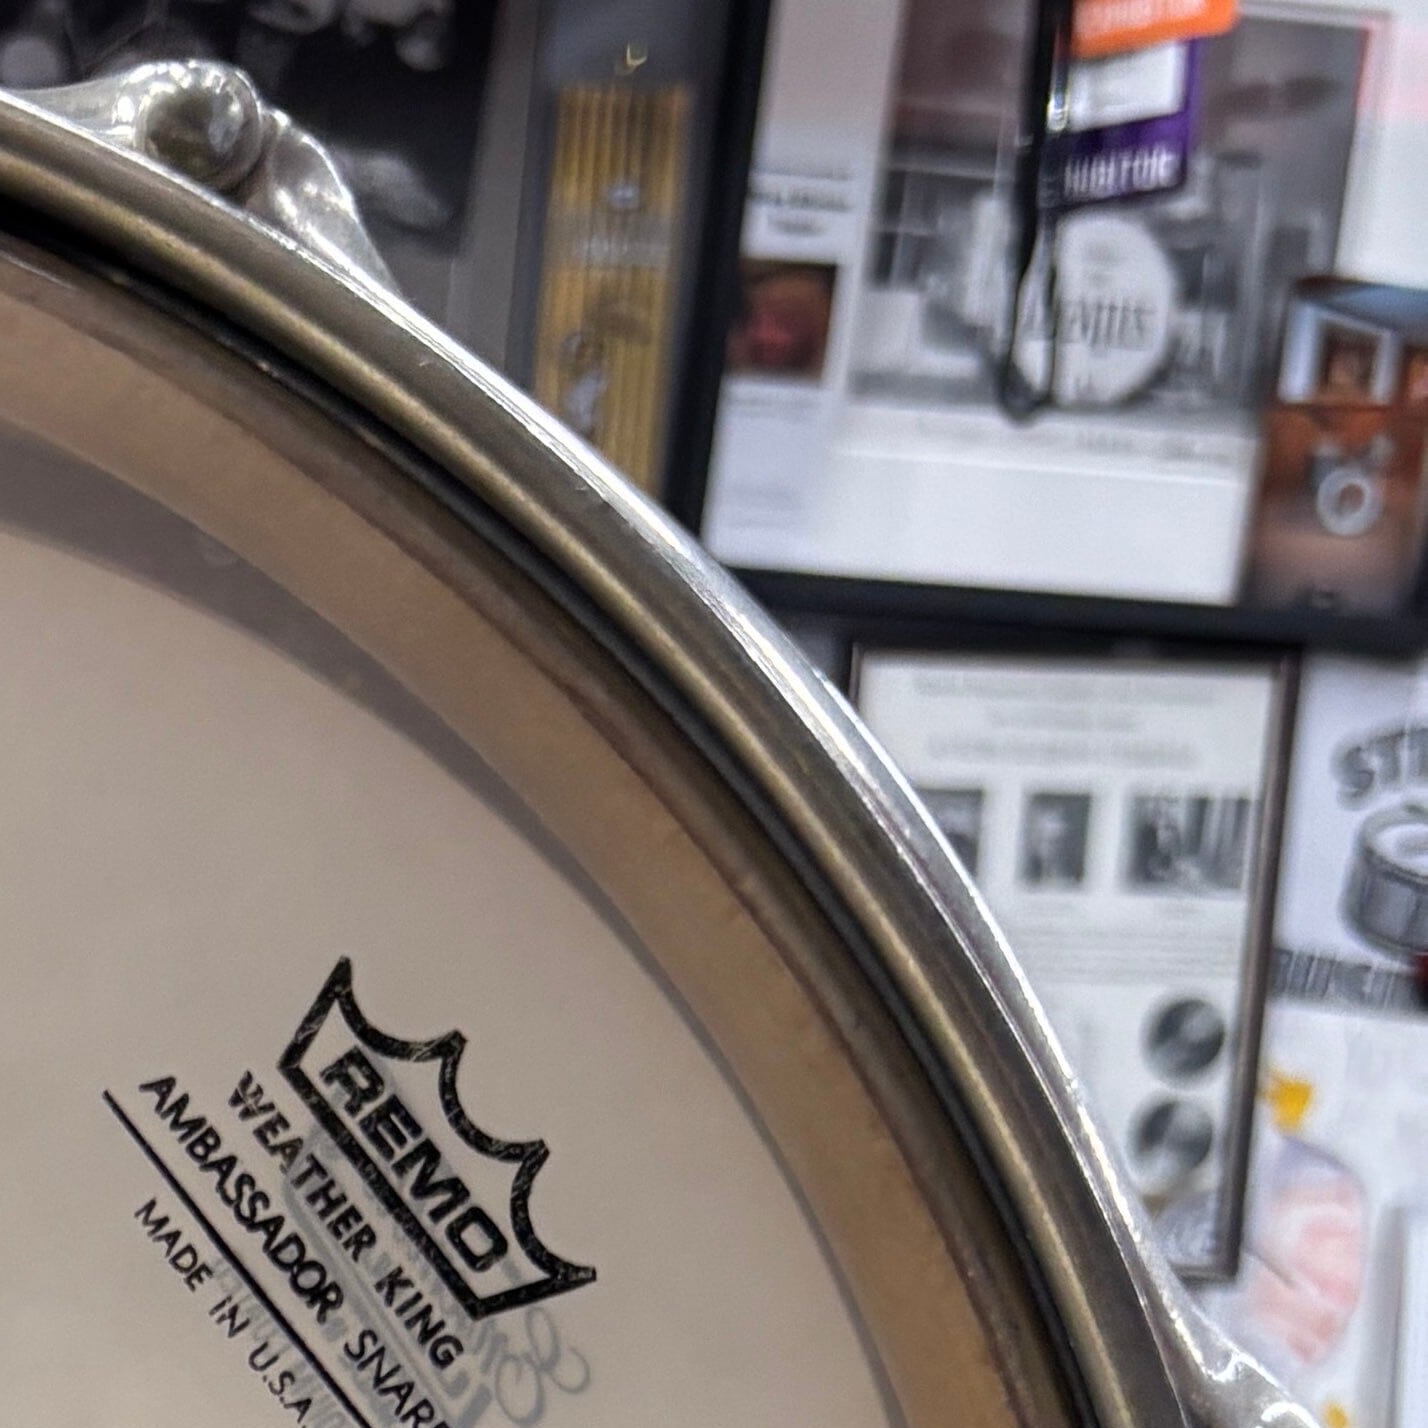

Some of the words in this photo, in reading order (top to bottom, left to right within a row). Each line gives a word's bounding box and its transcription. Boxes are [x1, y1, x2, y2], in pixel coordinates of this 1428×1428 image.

[134, 1199, 212, 1293] MADE
[209, 1299, 250, 1338] IN
[139, 1076, 343, 1325] AMBASSADOR
[227, 1071, 376, 1262] WEATHER
[375, 1266, 464, 1369] KING
[321, 1047, 509, 1272] REMO
